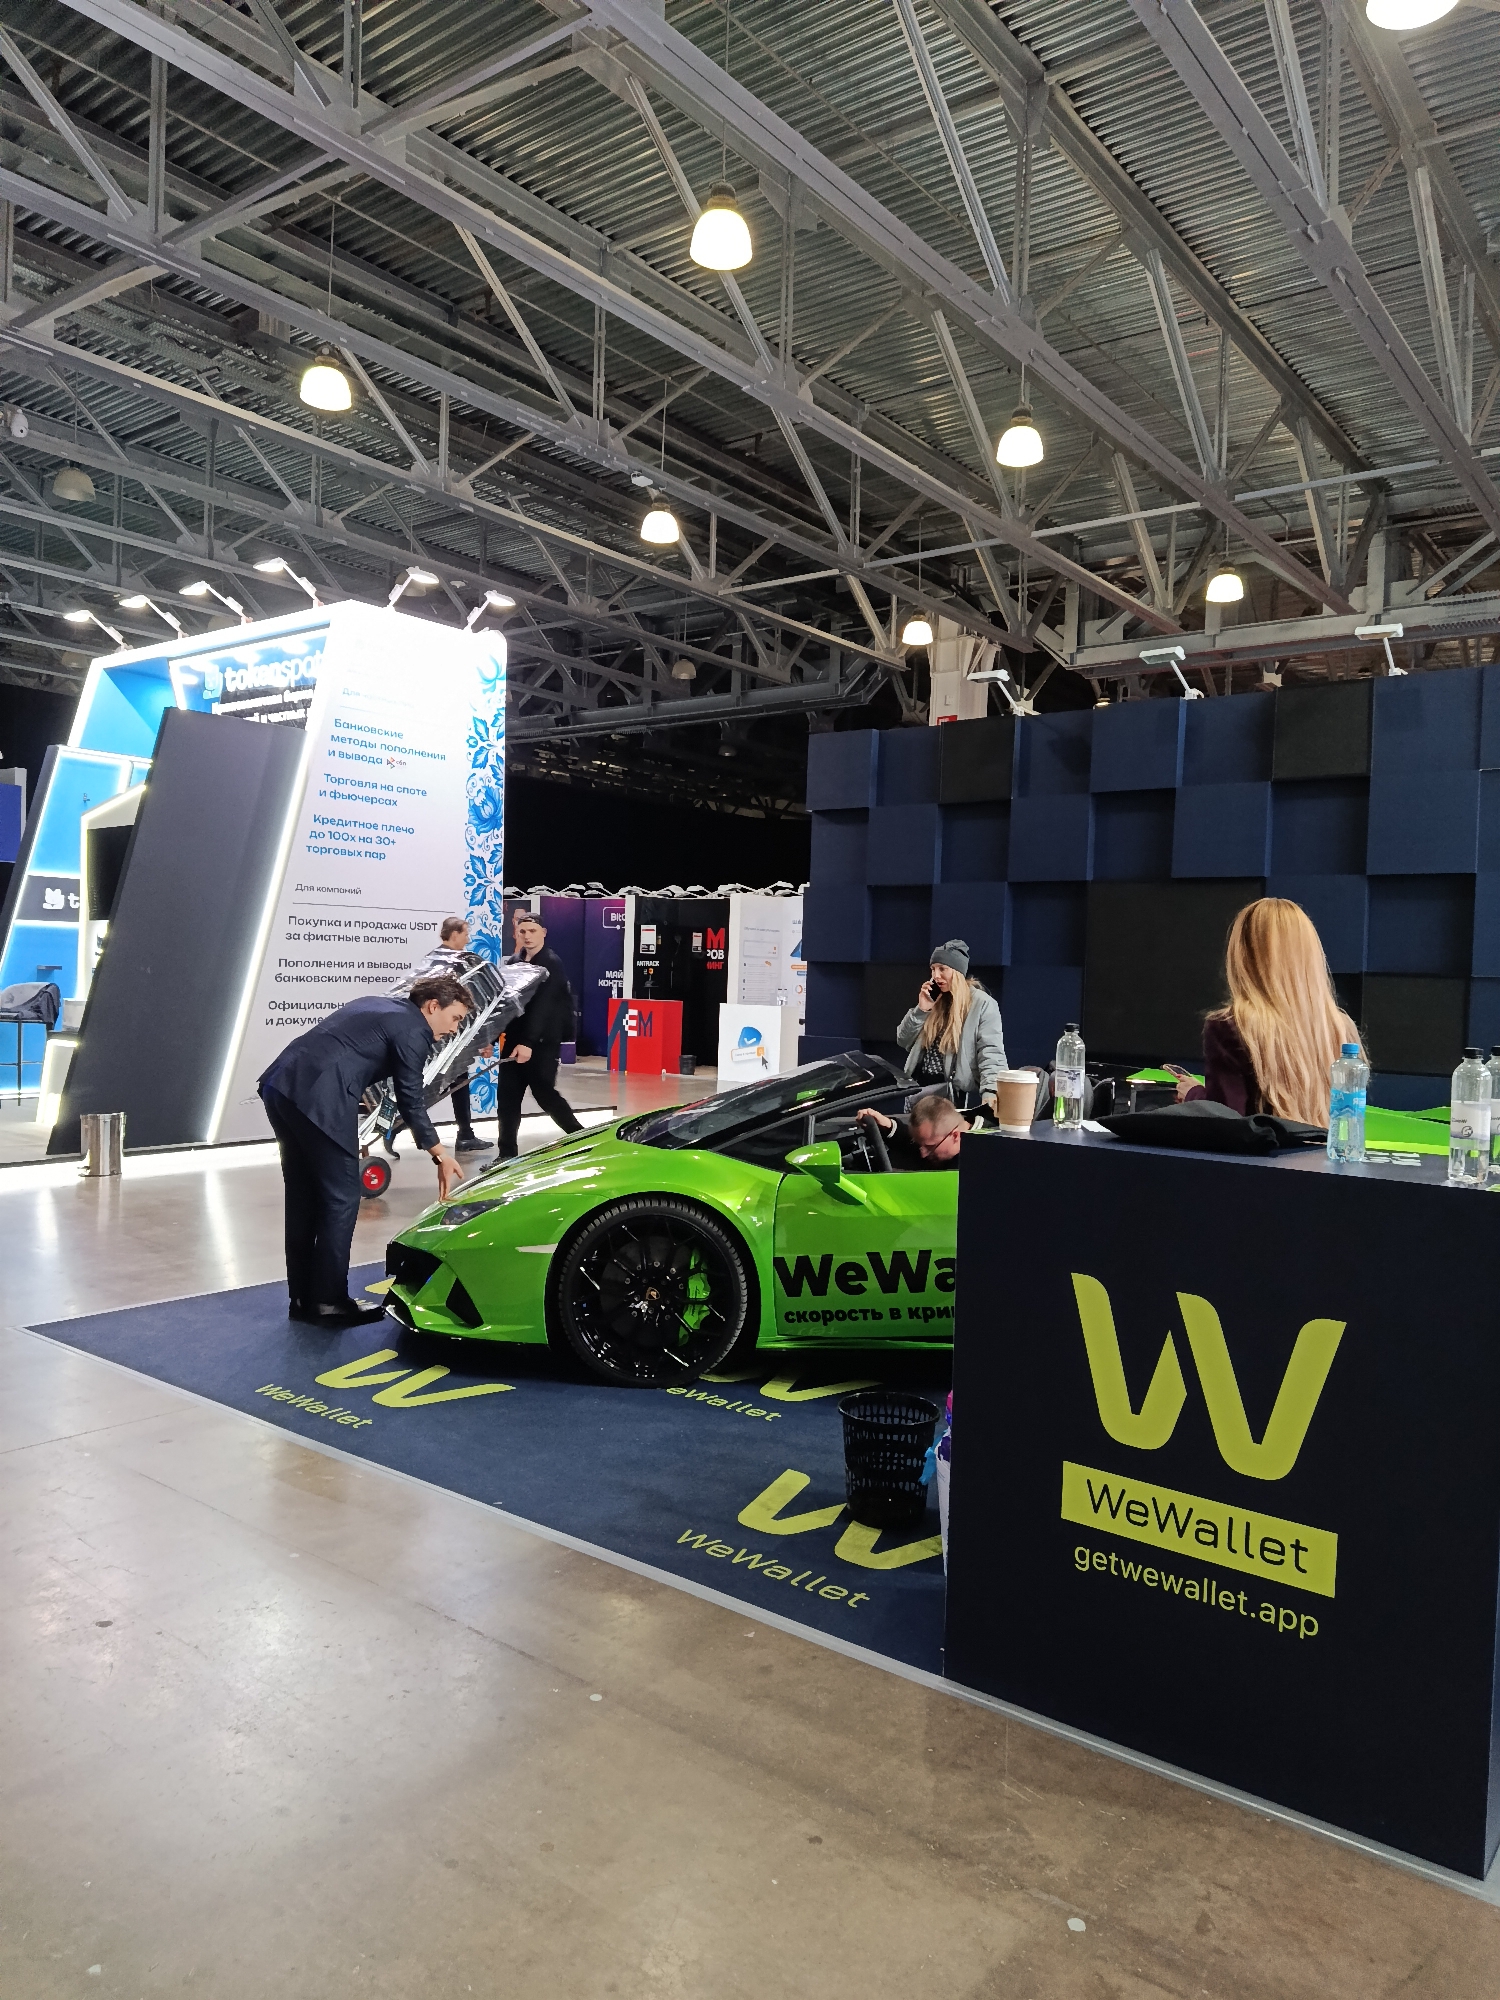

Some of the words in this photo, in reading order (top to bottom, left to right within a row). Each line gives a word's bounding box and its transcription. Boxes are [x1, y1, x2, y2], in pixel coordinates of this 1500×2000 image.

[334, 719, 404, 739] Банковские
[328, 749, 336, 757] и
[338, 750, 383, 765] вывода
[330, 734, 377, 749] методы
[380, 743, 446, 761] пополнения
[324, 773, 378, 789] Торговля
[380, 784, 394, 792] на
[396, 786, 427, 797] споте
[319, 789, 327, 798] и
[329, 789, 398, 806] фьючерсах
[313, 813, 379, 831] Кредитное
[381, 823, 415, 835] плечо
[309, 830, 326, 840] до
[358, 835, 373, 844] на
[375, 835, 396, 846] 30+
[306, 844, 363, 857] торговых
[364, 851, 387, 860] пар
[295, 883, 315, 892] Для
[316, 886, 362, 895] компаний
[288, 915, 342, 928] Покупка
[344, 920, 352, 928] и
[354, 920, 407, 931] продажа
[409, 921, 438, 931] USDT
[285, 932, 301, 941] за
[303, 931, 361, 943] фиатные
[363, 934, 408, 944] валюты
[278, 958, 355, 968] Пополнения
[357, 961, 365, 969] и
[367, 961, 412, 970] выводы
[274, 972, 351, 983] банковским
[265, 1017, 274, 1026] и
[774, 1249, 956, 1298] WeWa
[784, 1308, 884, 1326] скорость
[889, 1307, 902, 1320] в
[255, 1383, 373, 1429] WeWallet
[666, 1386, 782, 1422] eWallet
[1086, 1478, 1309, 1574] WeWallet
[677, 1529, 870, 1607] WeWallet
[1074, 1546, 1319, 1639] getwewallet.app
